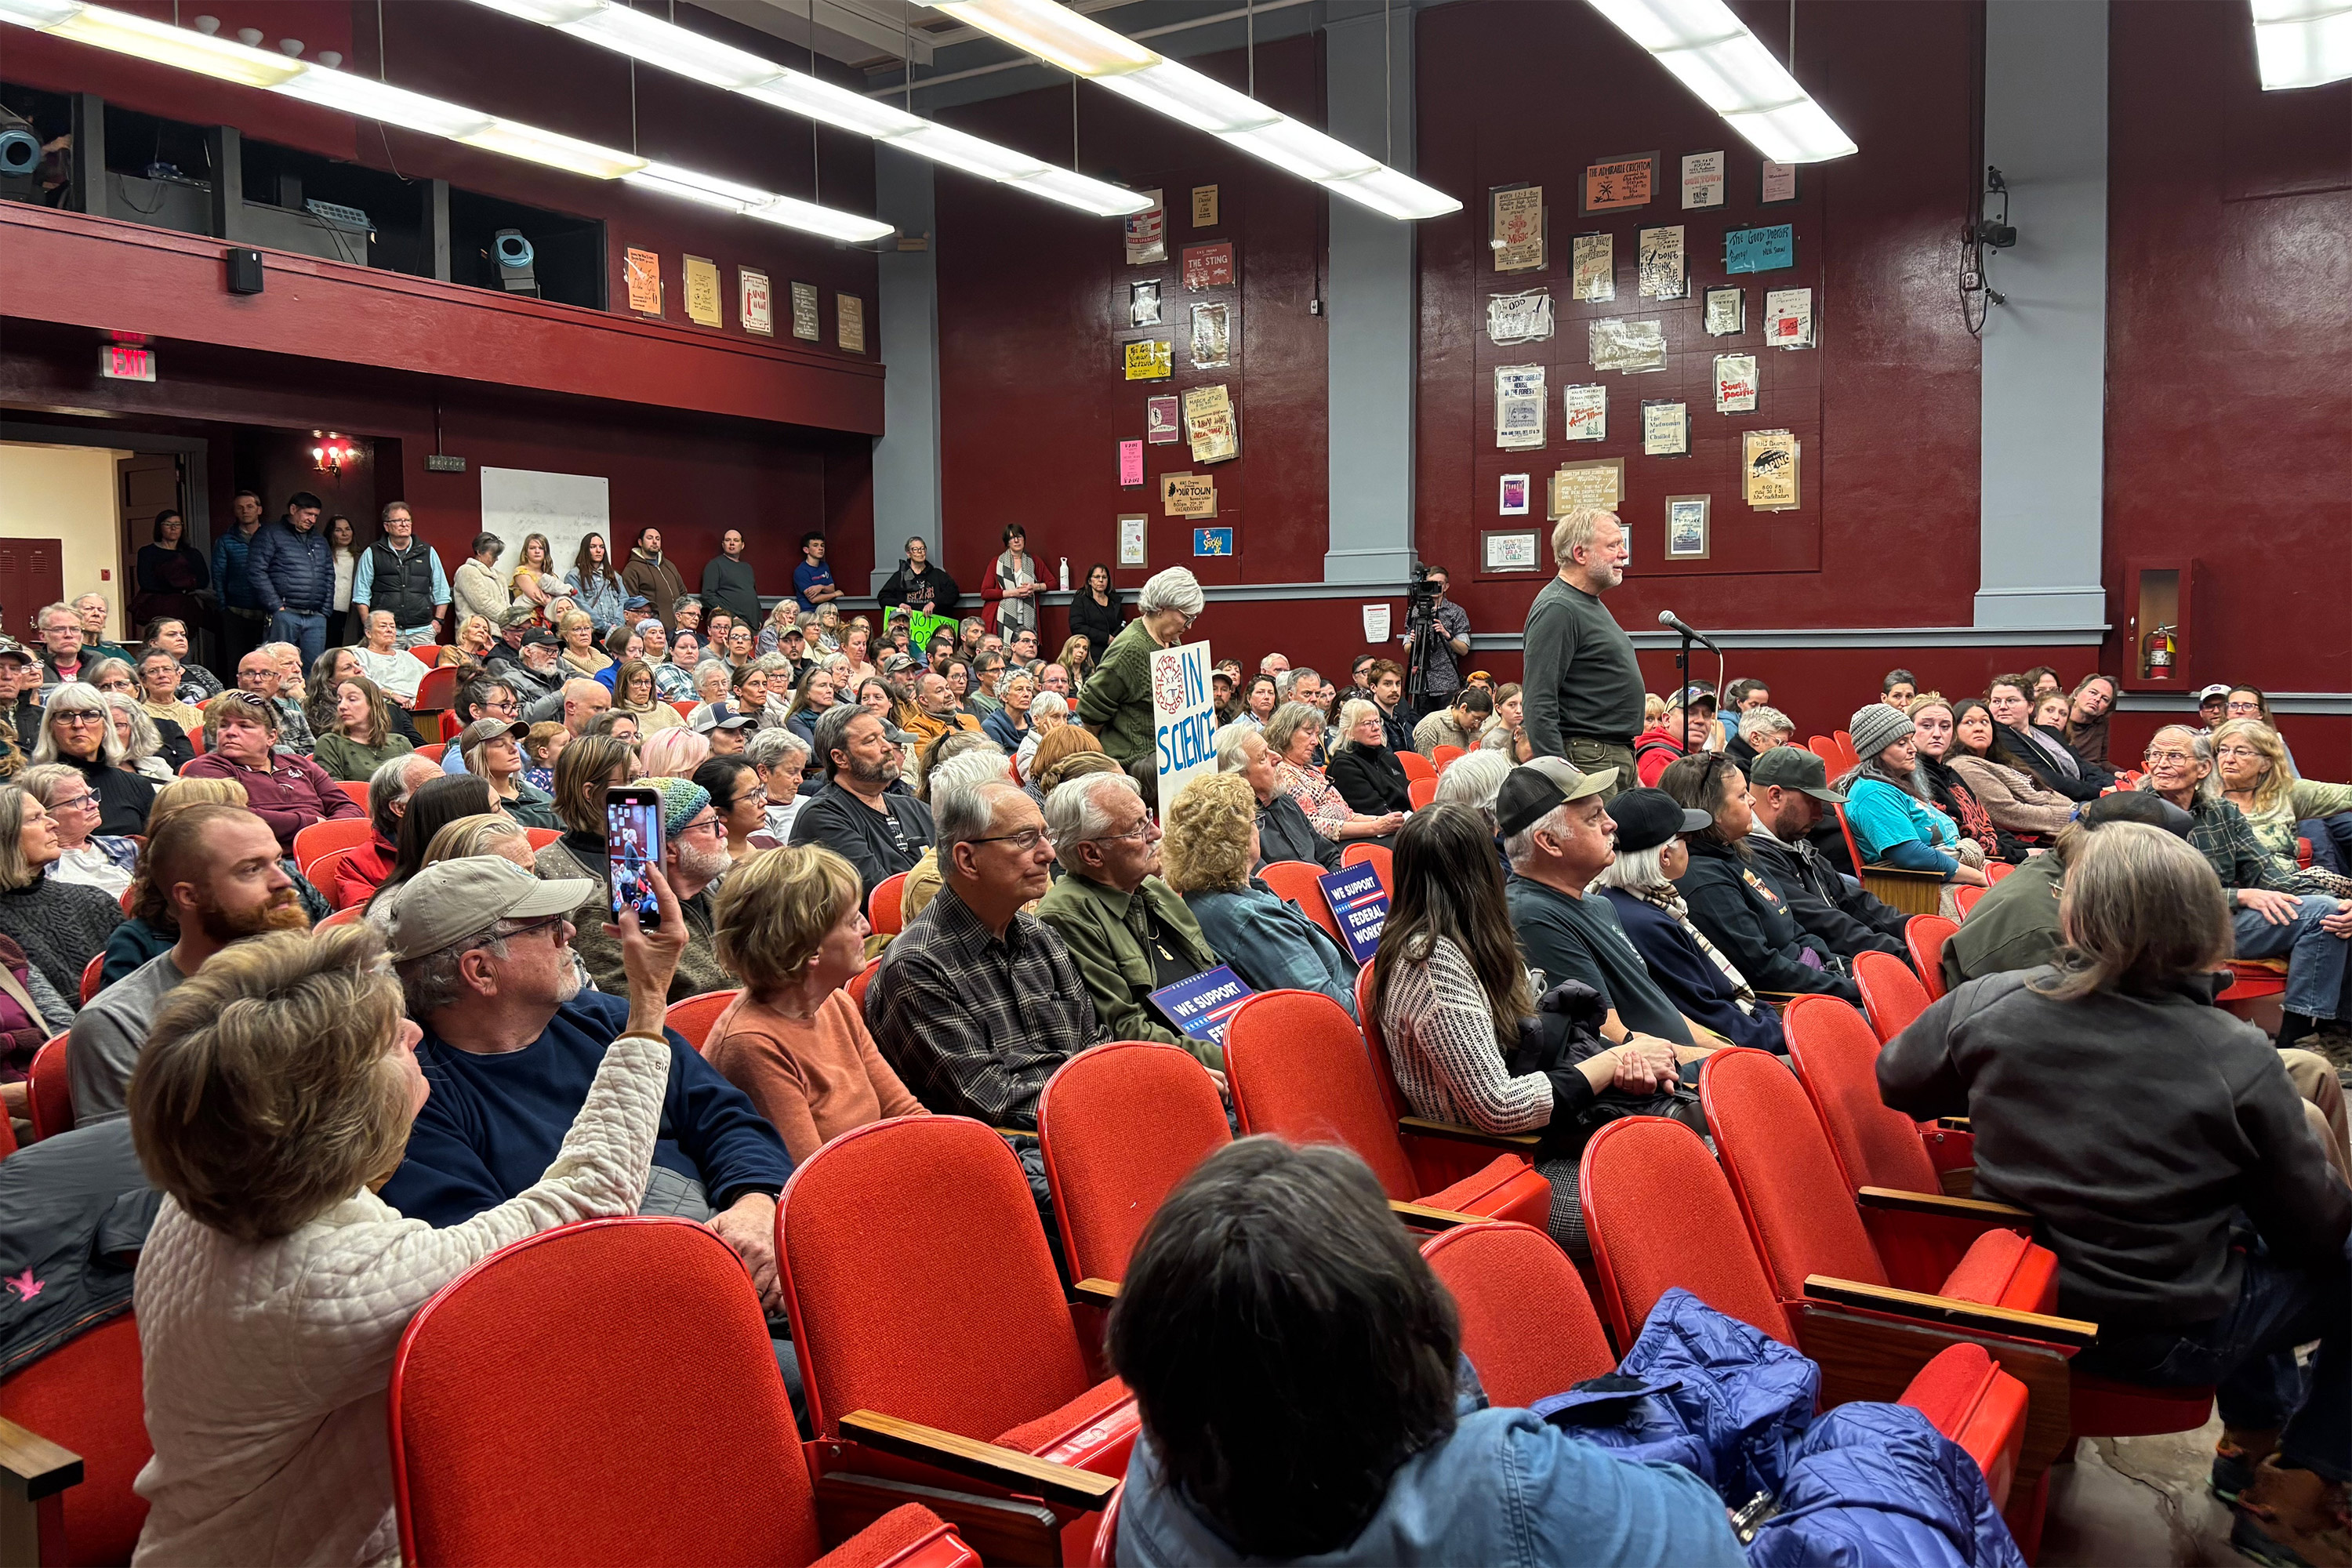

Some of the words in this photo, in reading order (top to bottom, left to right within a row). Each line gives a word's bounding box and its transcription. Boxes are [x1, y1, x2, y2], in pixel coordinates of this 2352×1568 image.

[1598, 163, 1625, 176] ADMIRABLE
[1574, 240, 1581, 251] A
[1189, 259, 1202, 268] THE
[1206, 254, 1228, 267] STING
[1508, 299, 1526, 310] ODD
[1499, 309, 1521, 321] Couple
[112, 347, 147, 378] EXIT
[1512, 373, 1541, 383] GINGERBREAD
[1720, 379, 1748, 392] South
[1753, 455, 1790, 477] SCAPINO
[1190, 486, 1210, 495] TOWN
[911, 613, 933, 629] NOT
[1181, 648, 1204, 709] IN
[1157, 706, 1218, 775] SCIENCE
[1331, 887, 1346, 901] WE
[1345, 877, 1375, 897] SUPPORT
[1348, 904, 1385, 928] FEDERAL
[1353, 920, 1385, 945] WORKE
[1173, 999, 1198, 1018] WE
[1193, 982, 1242, 1010] SUPPORT
